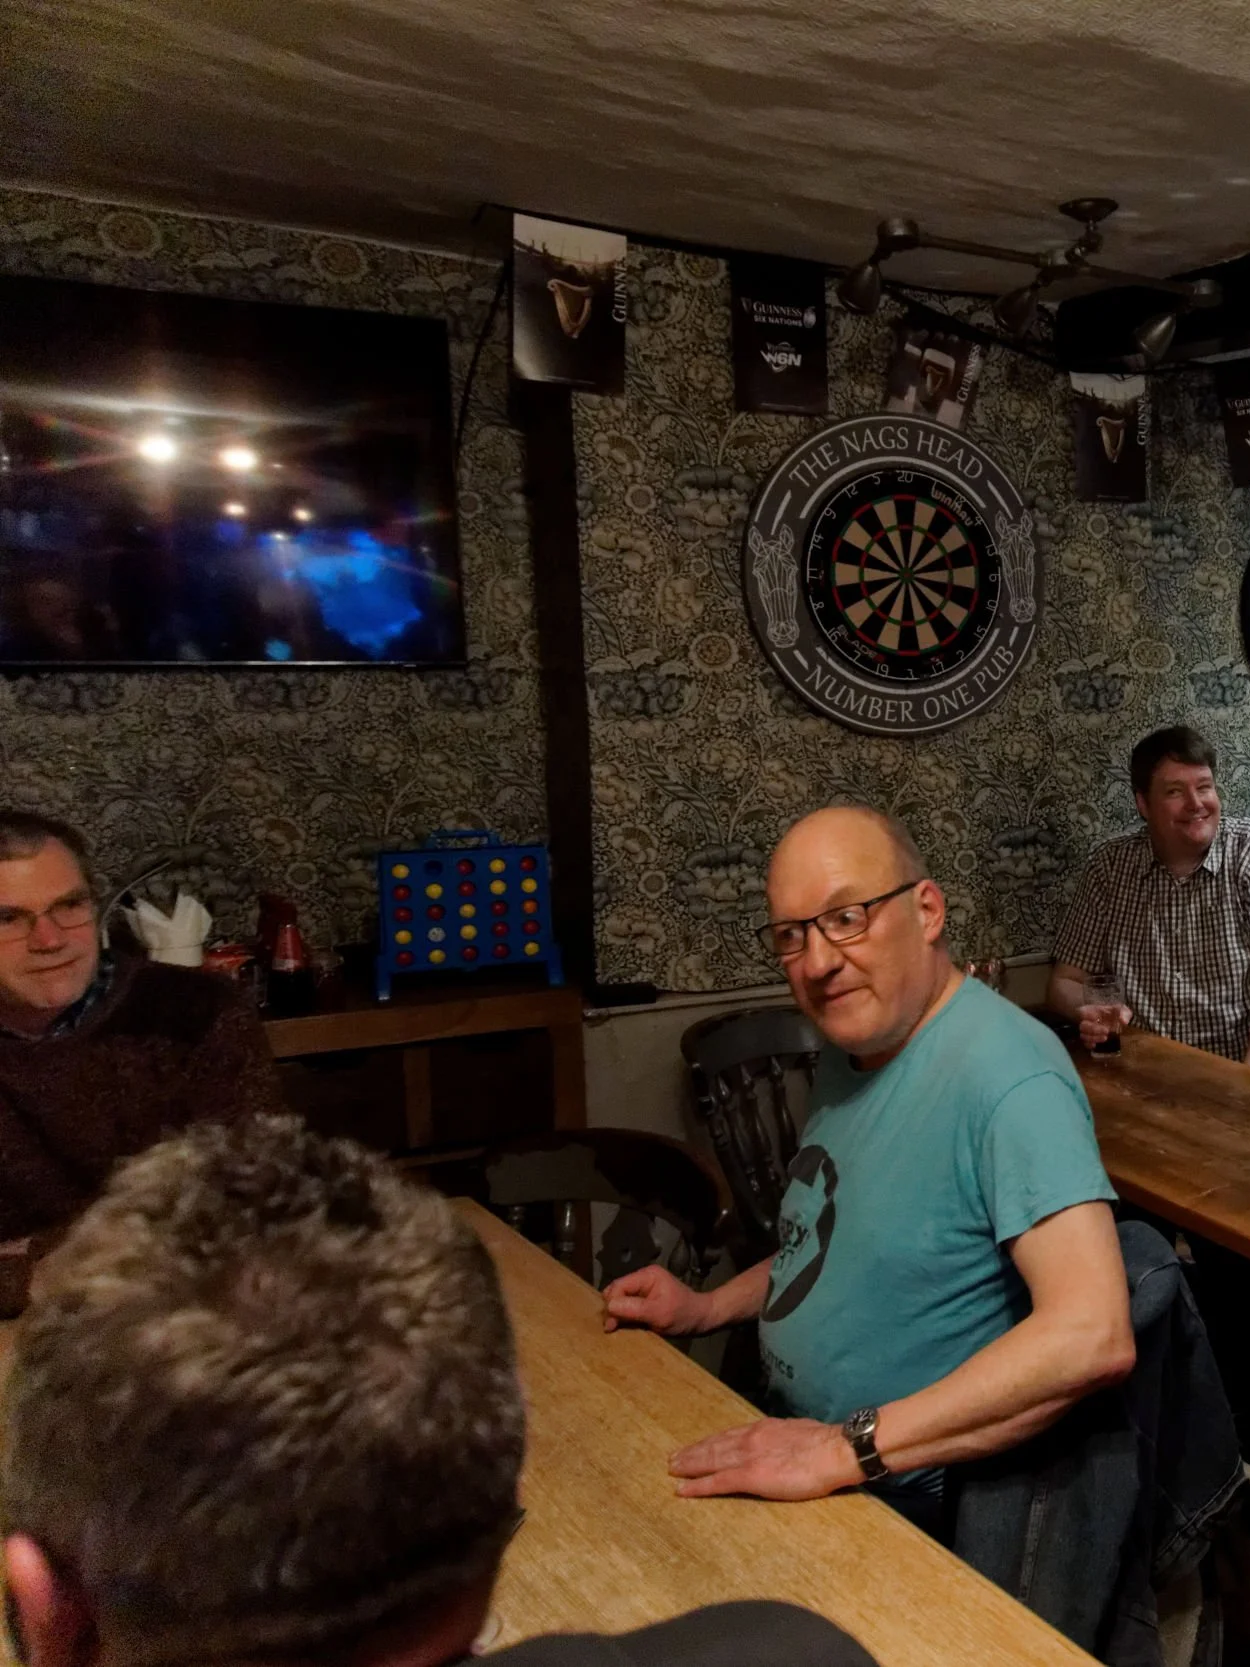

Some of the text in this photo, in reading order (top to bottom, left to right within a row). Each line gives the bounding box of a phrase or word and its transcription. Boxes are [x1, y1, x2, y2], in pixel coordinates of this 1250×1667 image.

[753, 301, 803, 317] GUINNESS
[768, 316, 803, 328] NATIONS
[956, 343, 982, 403] GUINNESS
[788, 425, 984, 491] THE NAGS HEAD
[896, 471, 914, 484] 20
[804, 645, 1015, 724] NUMBER ONE PUB
